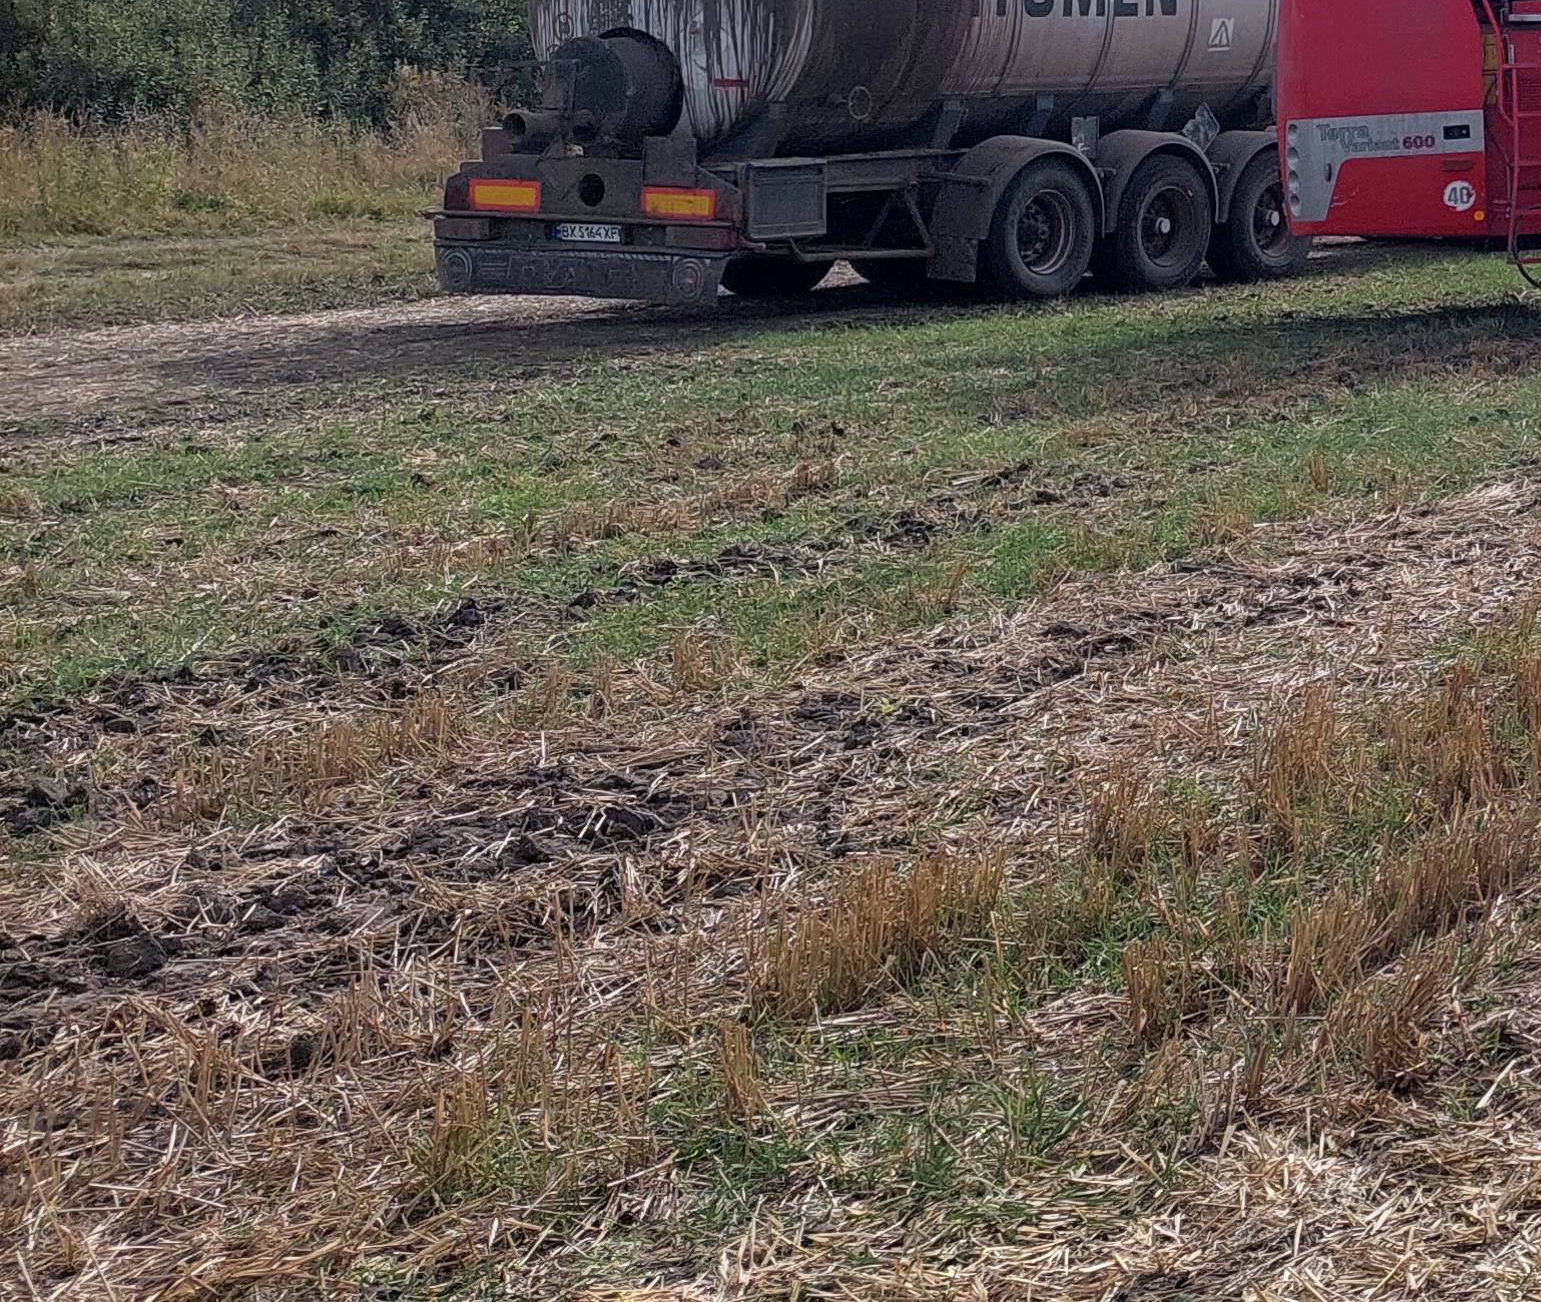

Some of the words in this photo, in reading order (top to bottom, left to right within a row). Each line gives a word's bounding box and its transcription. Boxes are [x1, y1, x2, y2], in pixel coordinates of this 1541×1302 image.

[1316, 124, 1368, 141] Terra
[1339, 137, 1399, 152] Variant
[1402, 134, 1435, 149] 600
[1447, 186, 1472, 205] 40
